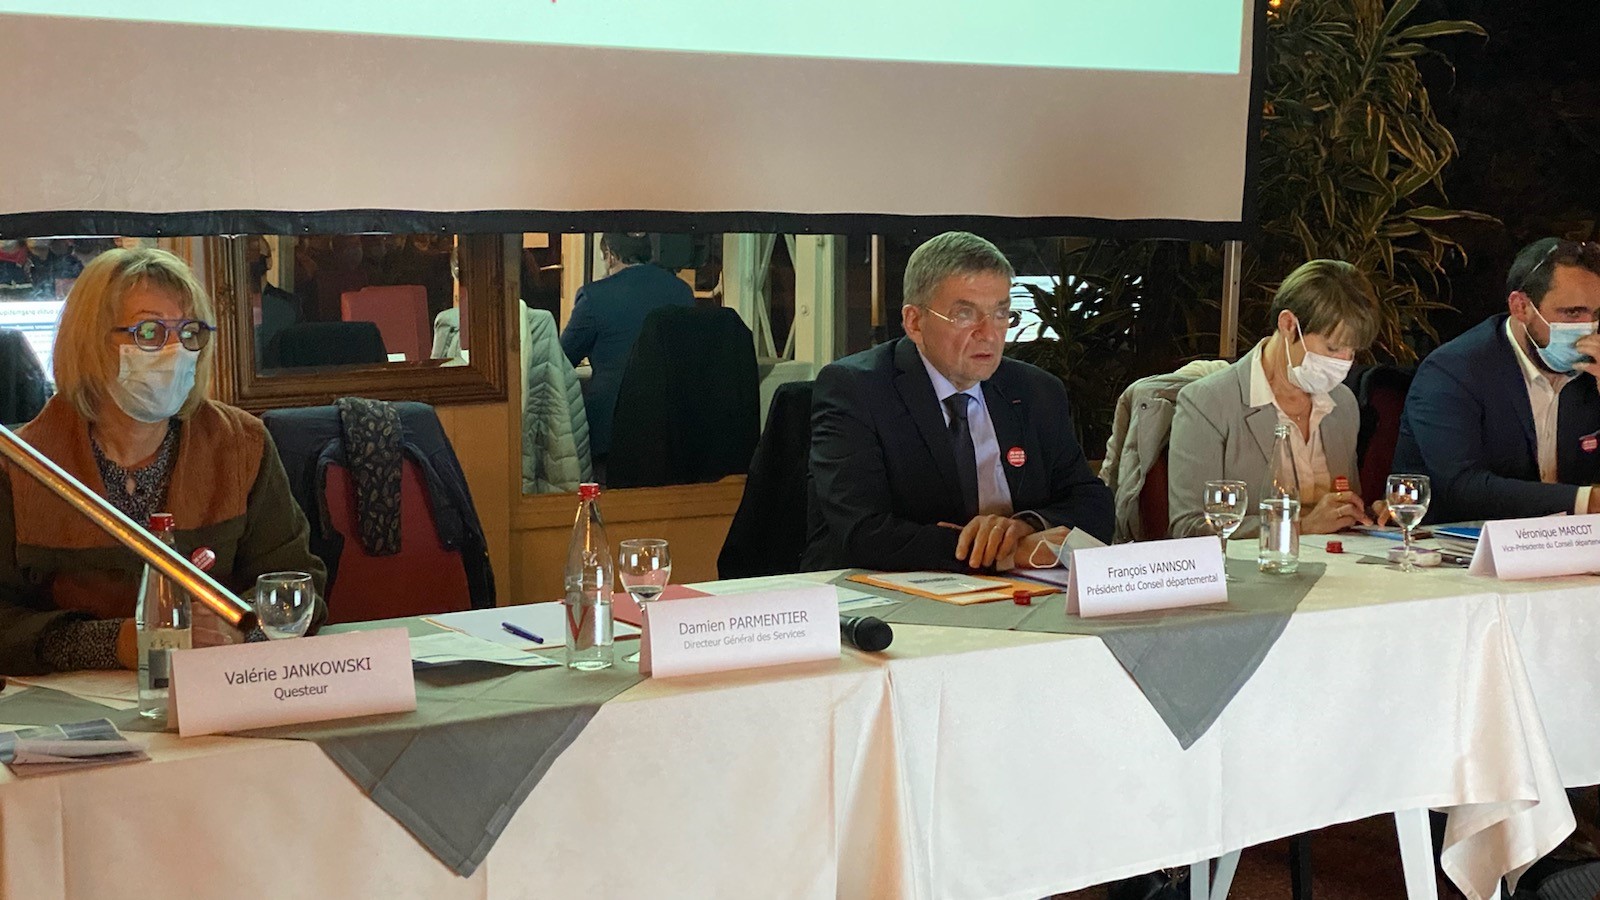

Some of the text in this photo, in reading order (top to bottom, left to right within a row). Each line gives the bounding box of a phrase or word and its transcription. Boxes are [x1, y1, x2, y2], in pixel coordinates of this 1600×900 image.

[1516, 525, 1592, 539] Véronique MARCOT
[1502, 543, 1545, 552] Vice-Présidente
[1555, 540, 1574, 548] Conseil
[1108, 559, 1196, 579] François VANNSON
[1086, 574, 1218, 596] Président du Conseil départemental
[679, 610, 809, 635] Damien PARMENTIER
[684, 629, 807, 649] Directeur Général des Services
[224, 657, 371, 685] Valérie JANKOWSKI
[274, 685, 328, 700] Questeur
